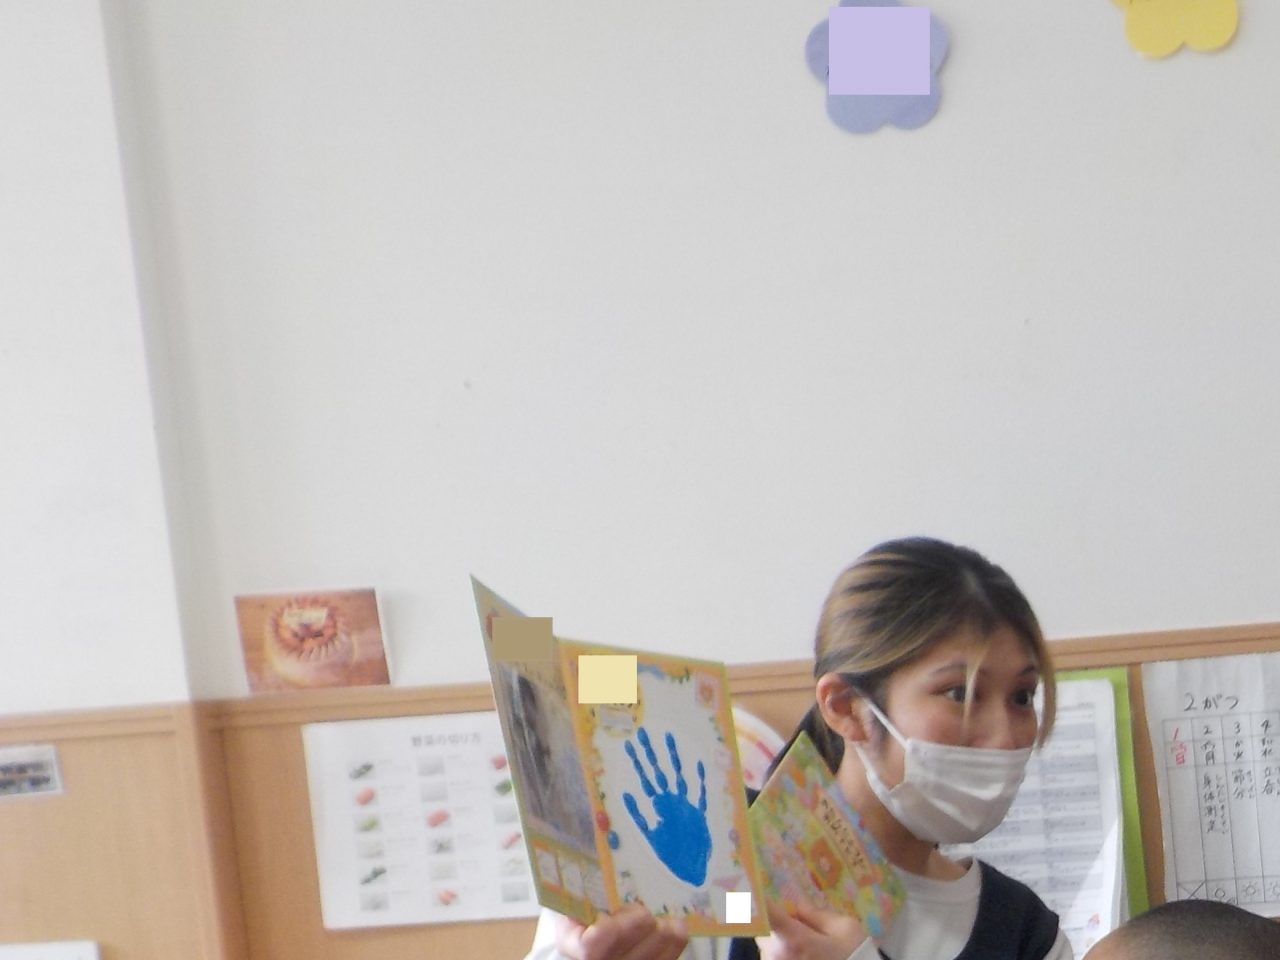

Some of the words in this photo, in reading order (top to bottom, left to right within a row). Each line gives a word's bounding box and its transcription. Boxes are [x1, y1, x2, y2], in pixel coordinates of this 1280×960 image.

[1183, 692, 1239, 712] 2がつ
[1173, 727, 1179, 740] 1
[1203, 726, 1213, 735] 2
[1234, 722, 1241, 734] 3
